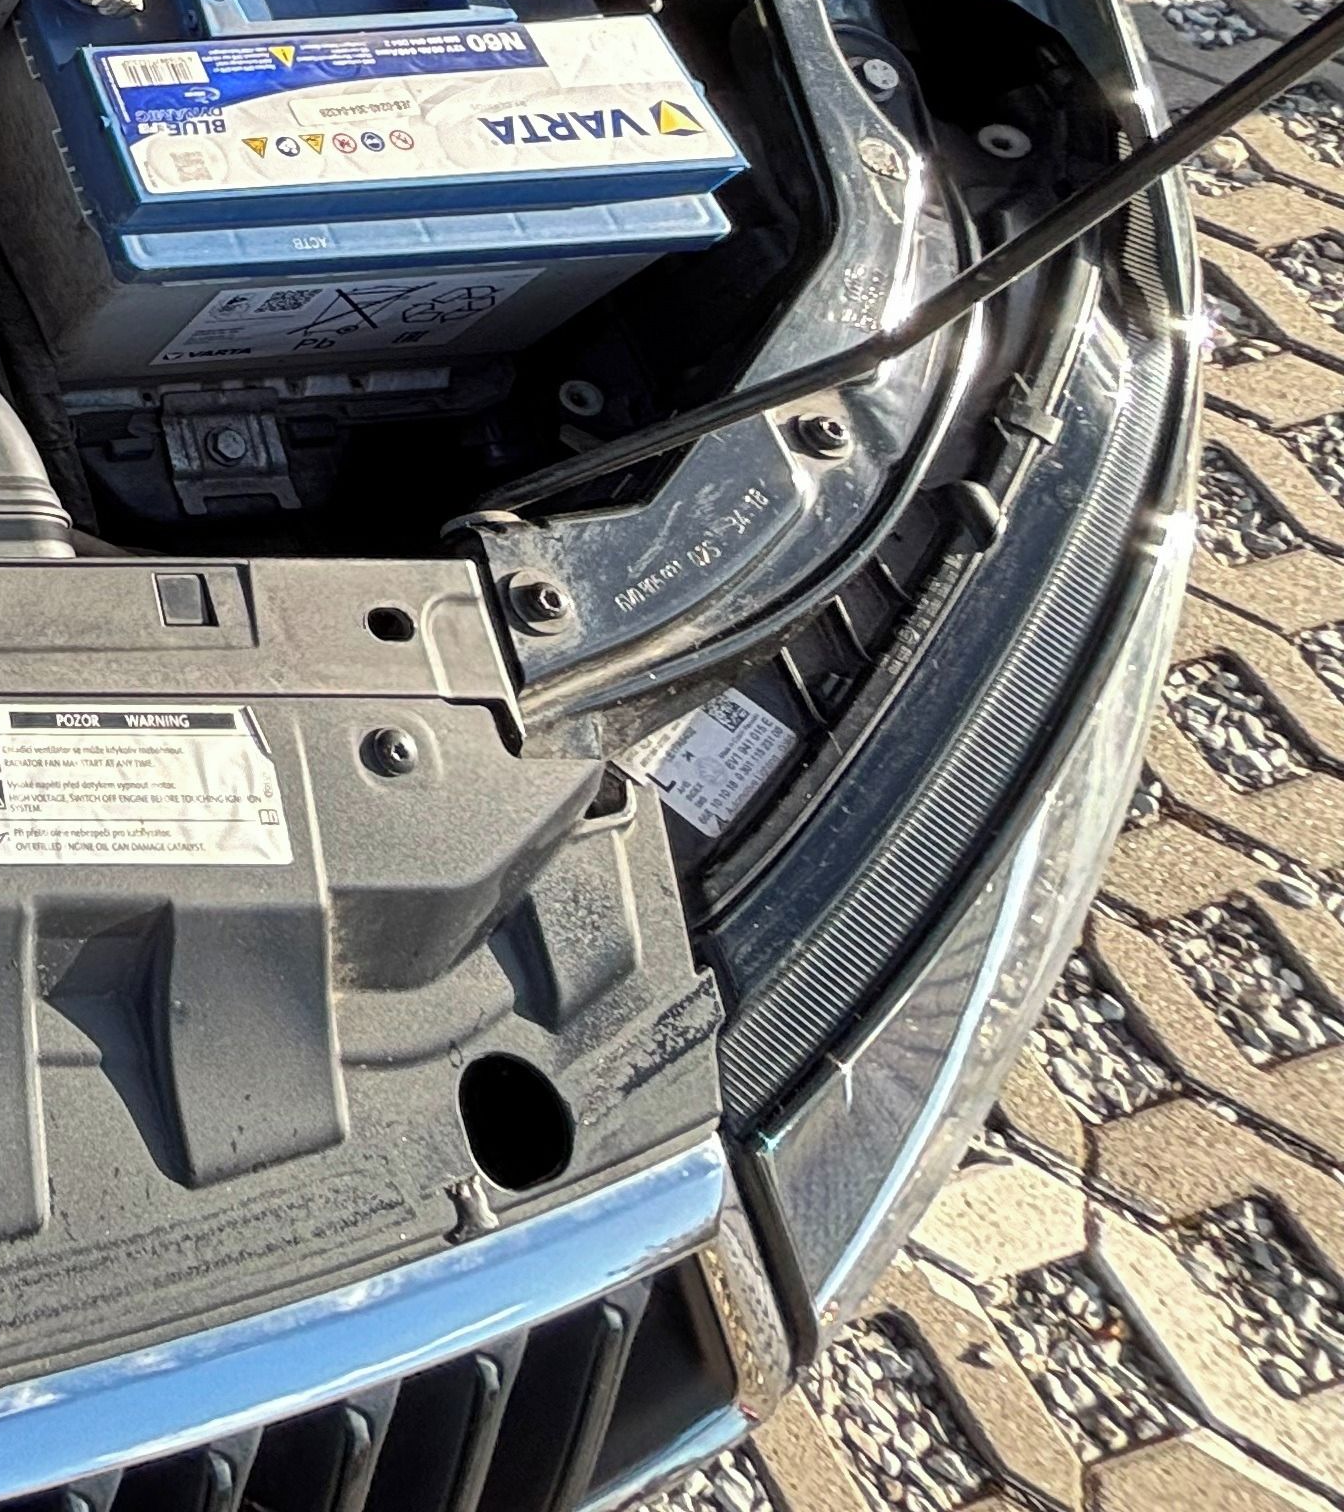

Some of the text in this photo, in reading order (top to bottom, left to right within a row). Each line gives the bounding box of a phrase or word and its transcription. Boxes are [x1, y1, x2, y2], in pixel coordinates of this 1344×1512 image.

[466, 32, 528, 52] N60
[168, 118, 227, 137] BLUE
[481, 112, 652, 147] VARTA
[292, 338, 336, 351] Pb
[188, 348, 252, 357] VARTA
[55, 713, 190, 728] POZOR WARNING
[4, 759, 44, 767] RAATOR
[645, 773, 676, 794] L
[150, 794, 180, 803] BEORE
